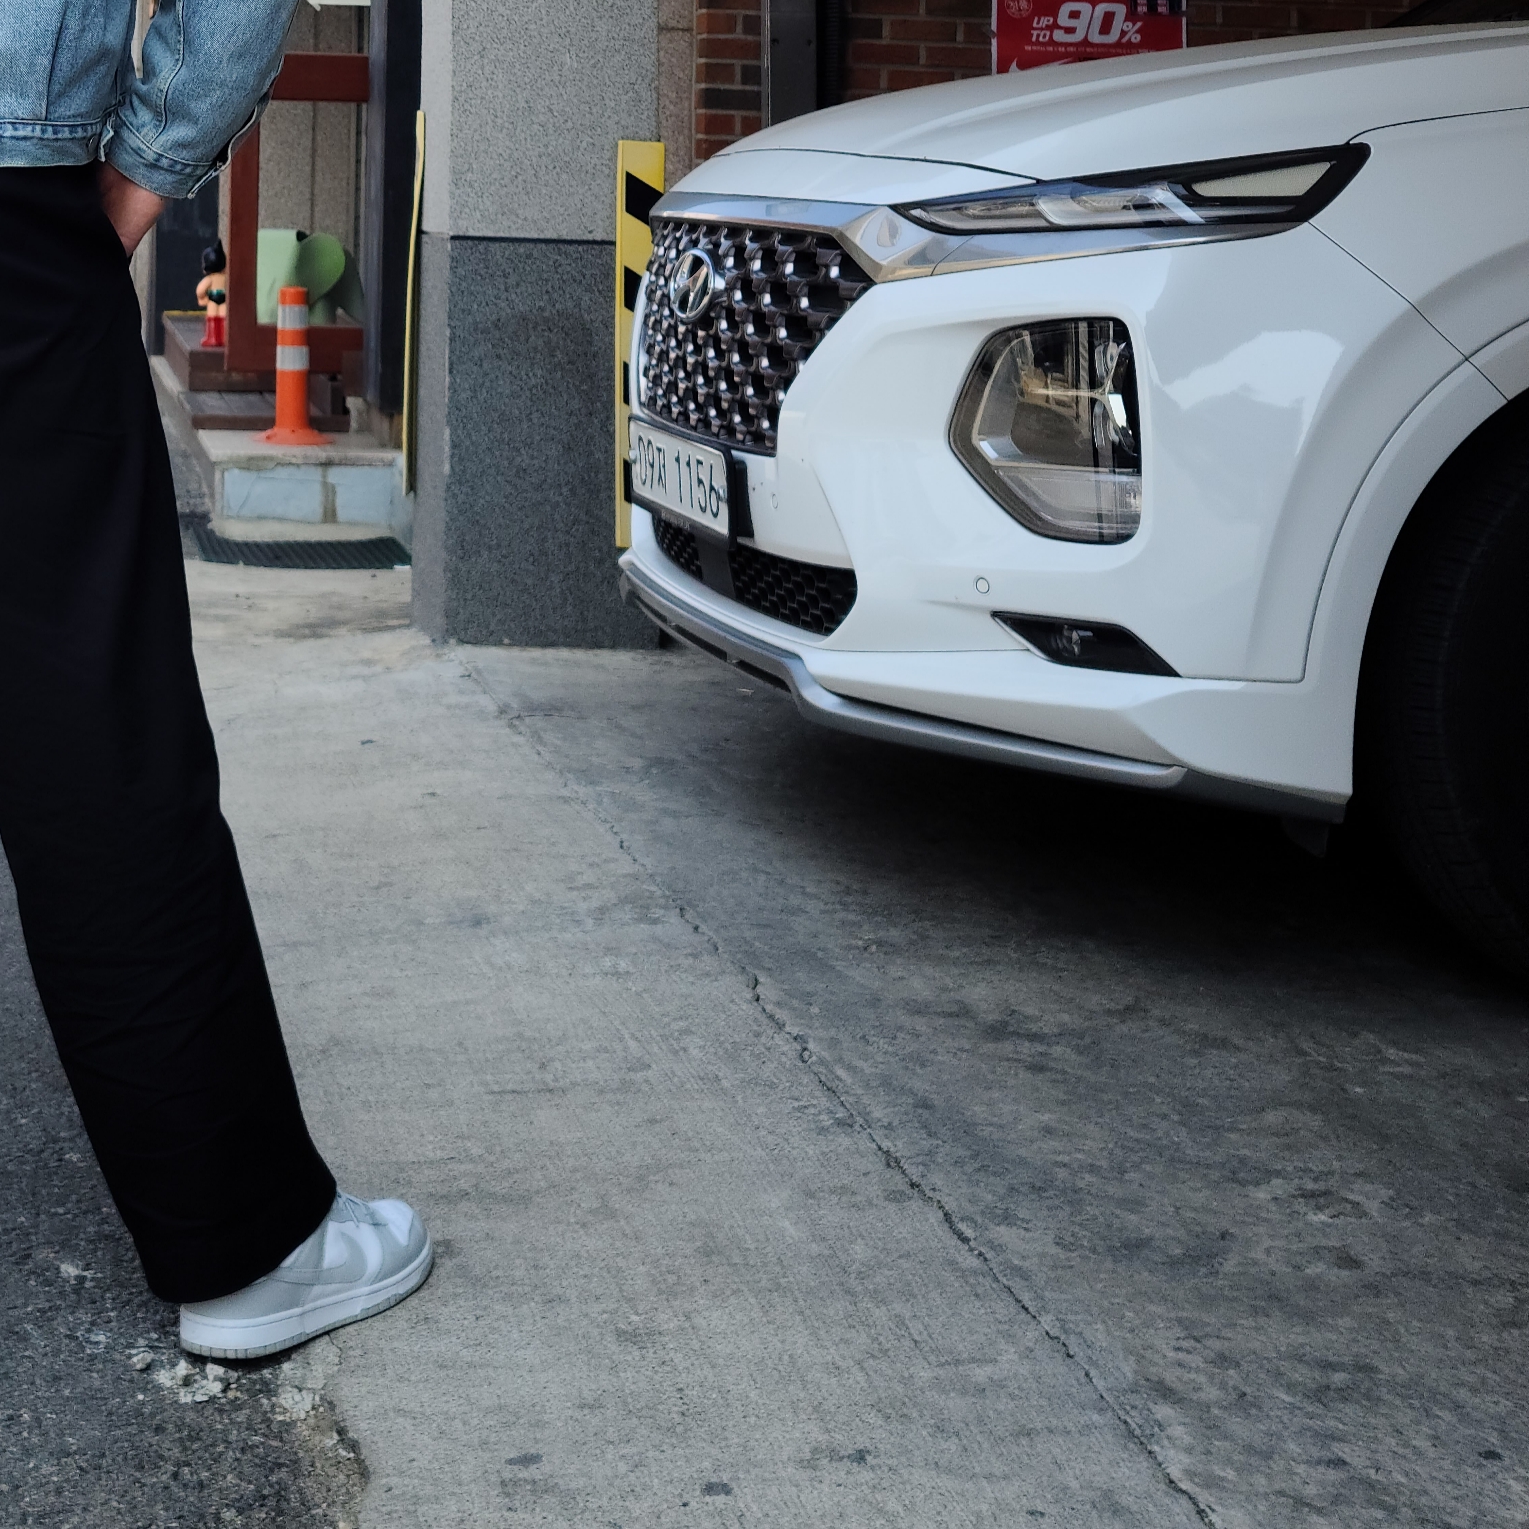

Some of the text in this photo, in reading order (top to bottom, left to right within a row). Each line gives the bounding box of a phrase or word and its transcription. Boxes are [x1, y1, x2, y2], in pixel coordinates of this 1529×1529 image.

[1032, 16, 1053, 28] UP
[1053, 1, 1143, 44] 90%
[1031, 30, 1051, 42] TO
[637, 434, 720, 518] 09저 1156
